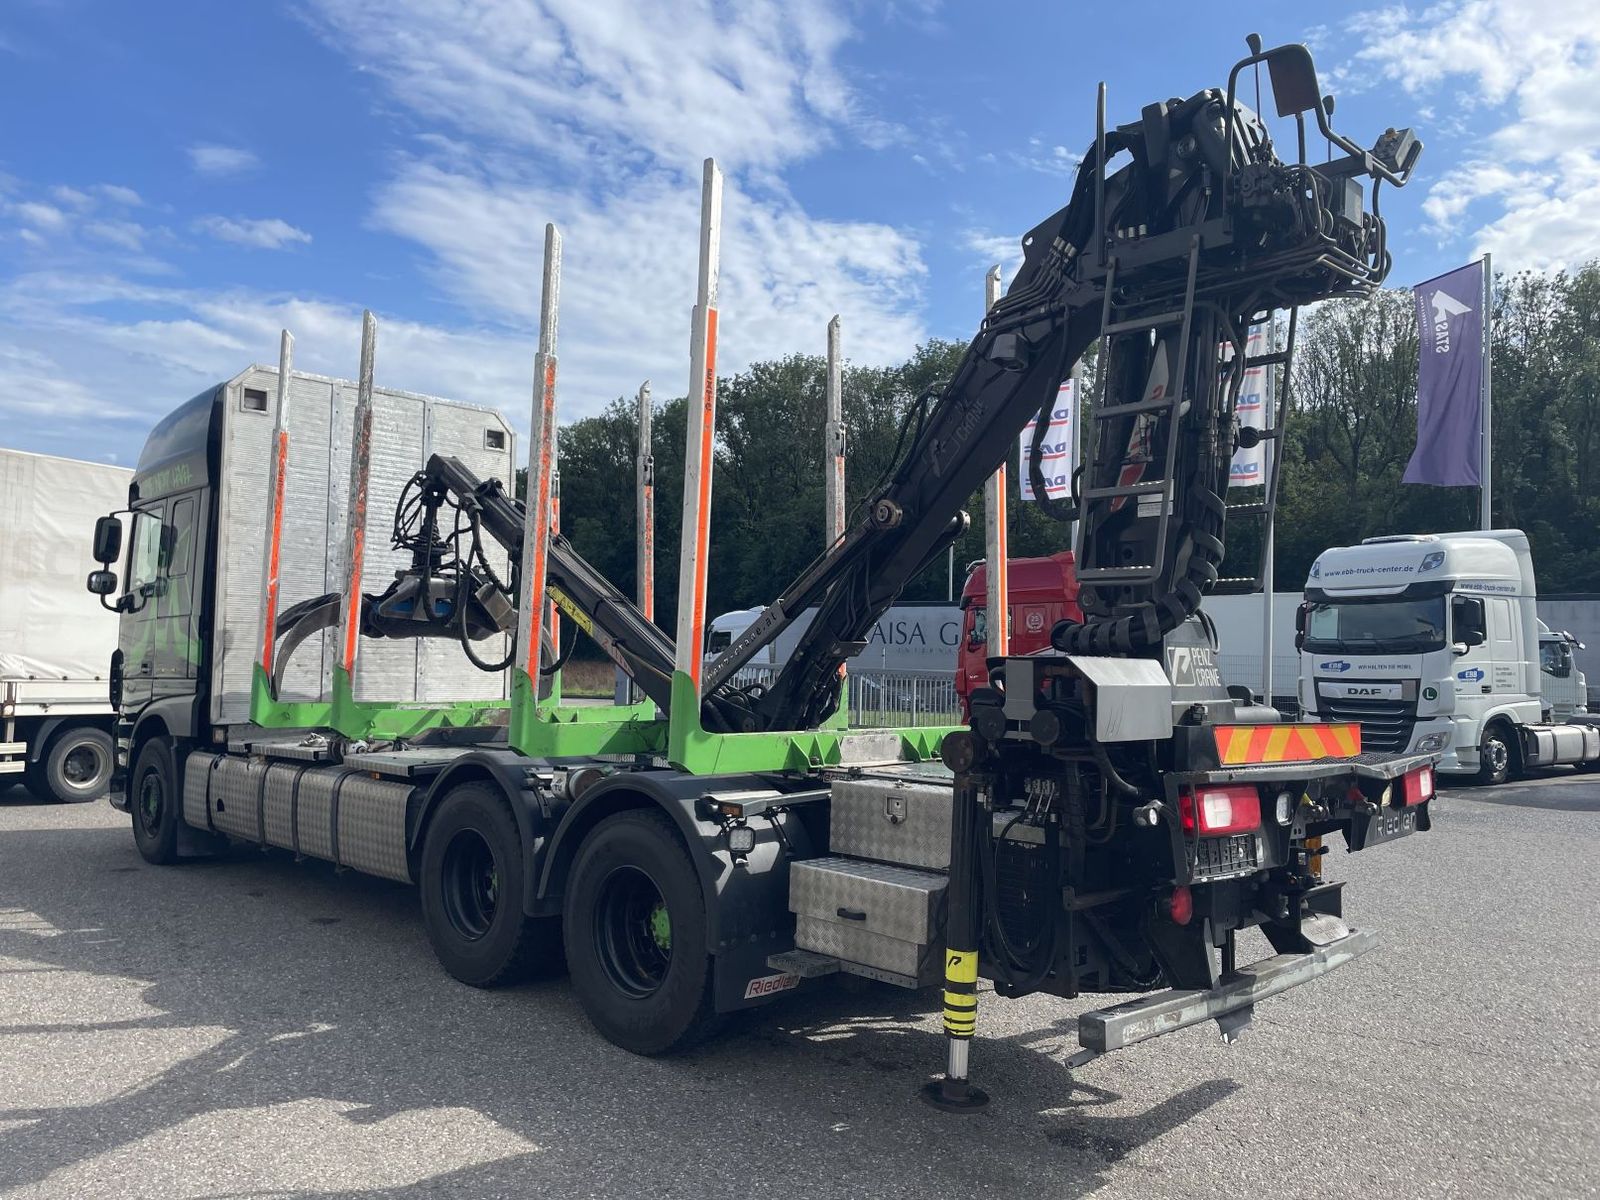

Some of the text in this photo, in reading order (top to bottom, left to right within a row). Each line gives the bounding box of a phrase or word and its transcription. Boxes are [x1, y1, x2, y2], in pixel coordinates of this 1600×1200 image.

[1324, 565, 1414, 577] www.ebb-truck-center.de
[870, 621, 959, 646] AISA G
[1191, 647, 1213, 666] PENZ
[1195, 668, 1221, 687] CRANE
[1465, 670, 1478, 678] EBB
[1347, 687, 1382, 695] DAF
